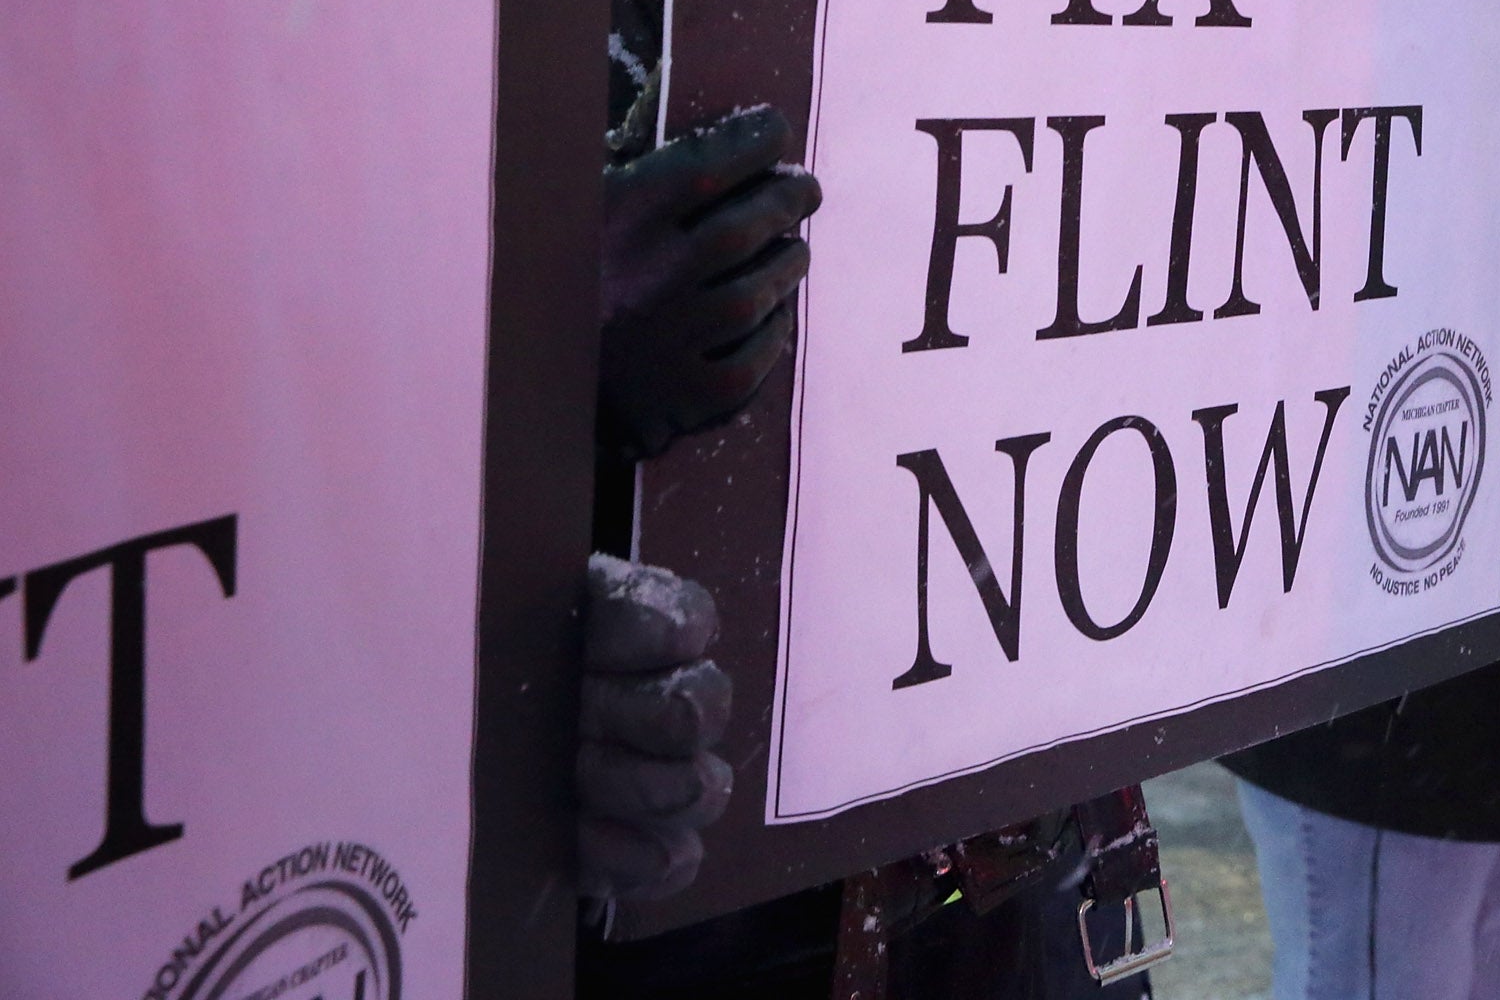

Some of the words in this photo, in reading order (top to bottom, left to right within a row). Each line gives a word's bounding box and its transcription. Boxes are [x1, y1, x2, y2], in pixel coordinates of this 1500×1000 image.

[902, 103, 1424, 354] FLINT
[1363, 345, 1414, 432] NATIONAL
[1417, 328, 1455, 354] ACTION
[1456, 333, 1493, 409] NETWORK
[1382, 420, 1468, 507] NAN
[892, 386, 1352, 691] NOW
[1395, 504, 1430, 523] Founded
[1432, 500, 1450, 514] 1991
[1370, 562, 1383, 585] NO
[1382, 578, 1419, 596] JUSTICE
[1424, 573, 1438, 591] NO
[240, 842, 330, 910] ACTION
[333, 841, 417, 934] NETWORK
